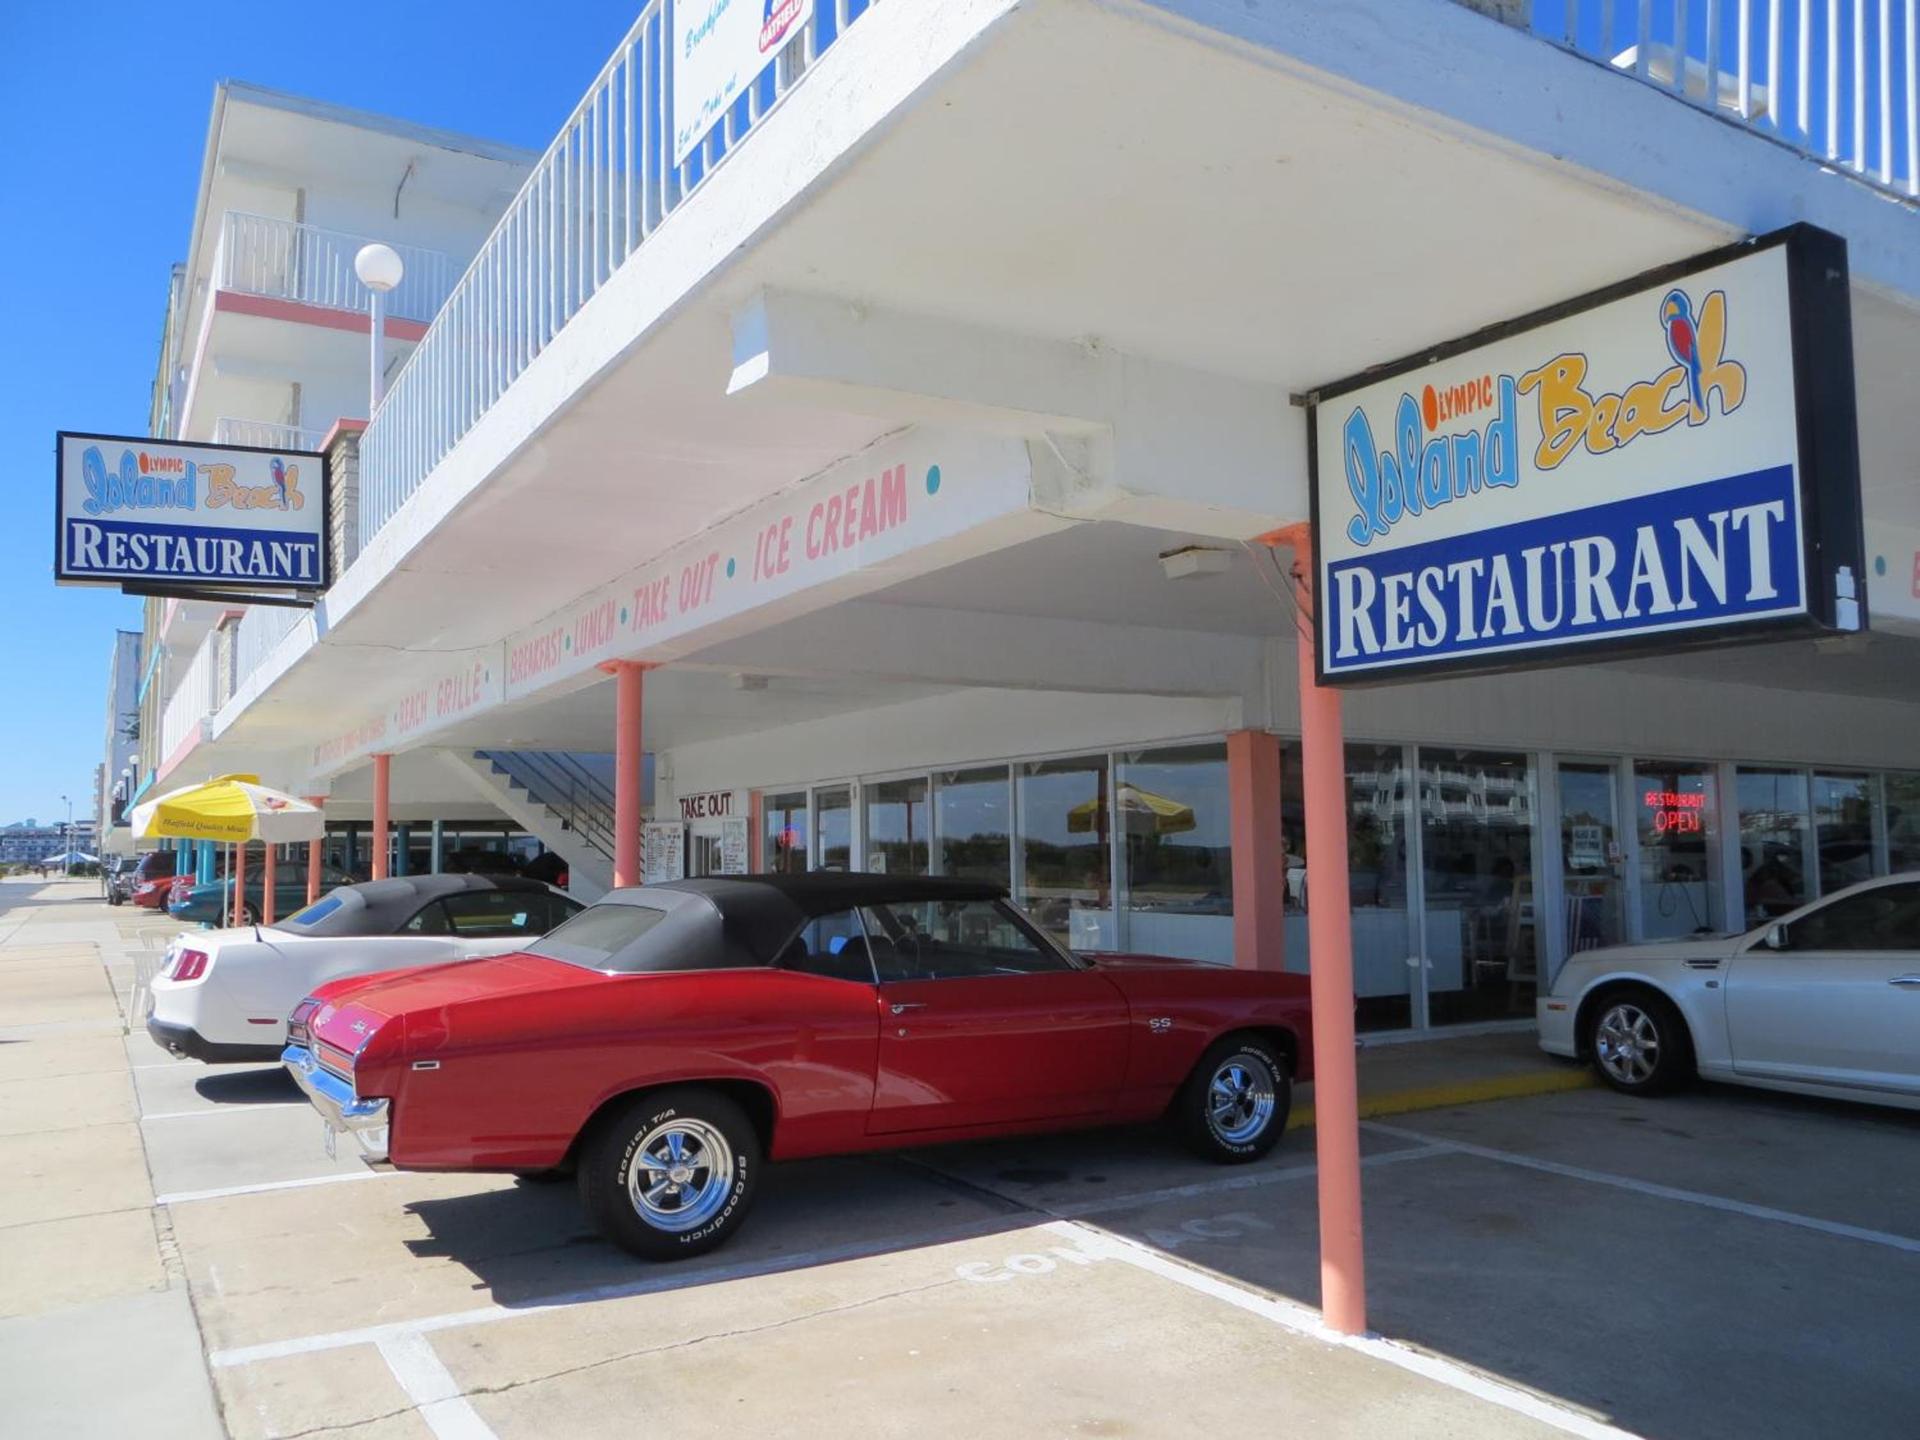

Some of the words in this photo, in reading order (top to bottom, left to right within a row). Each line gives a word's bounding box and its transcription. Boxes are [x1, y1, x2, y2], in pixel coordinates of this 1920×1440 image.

[1422, 374, 1494, 431] OLYMPIC
[1517, 290, 1746, 470] Beach
[139, 452, 183, 474] OLYMPIC
[198, 463, 304, 511] Beach
[71, 522, 316, 578] RESTAURANT
[510, 627, 564, 684] BREAKFAST
[574, 600, 616, 656] LUNCH
[632, 575, 670, 632] TAKE
[679, 553, 719, 614] OUT
[753, 516, 794, 583] ICE
[806, 463, 908, 560] CREAM
[1334, 500, 1785, 659] RESTAURANT
[679, 796, 706, 819] TAKE
[708, 792, 732, 816] OUT
[1644, 791, 1706, 808] RESTAURANT
[1655, 811, 1699, 832] OPEN
[1149, 1017, 1171, 1028] SS
[617, 1125, 648, 1185] Radial
[652, 1108, 677, 1124] T/A
